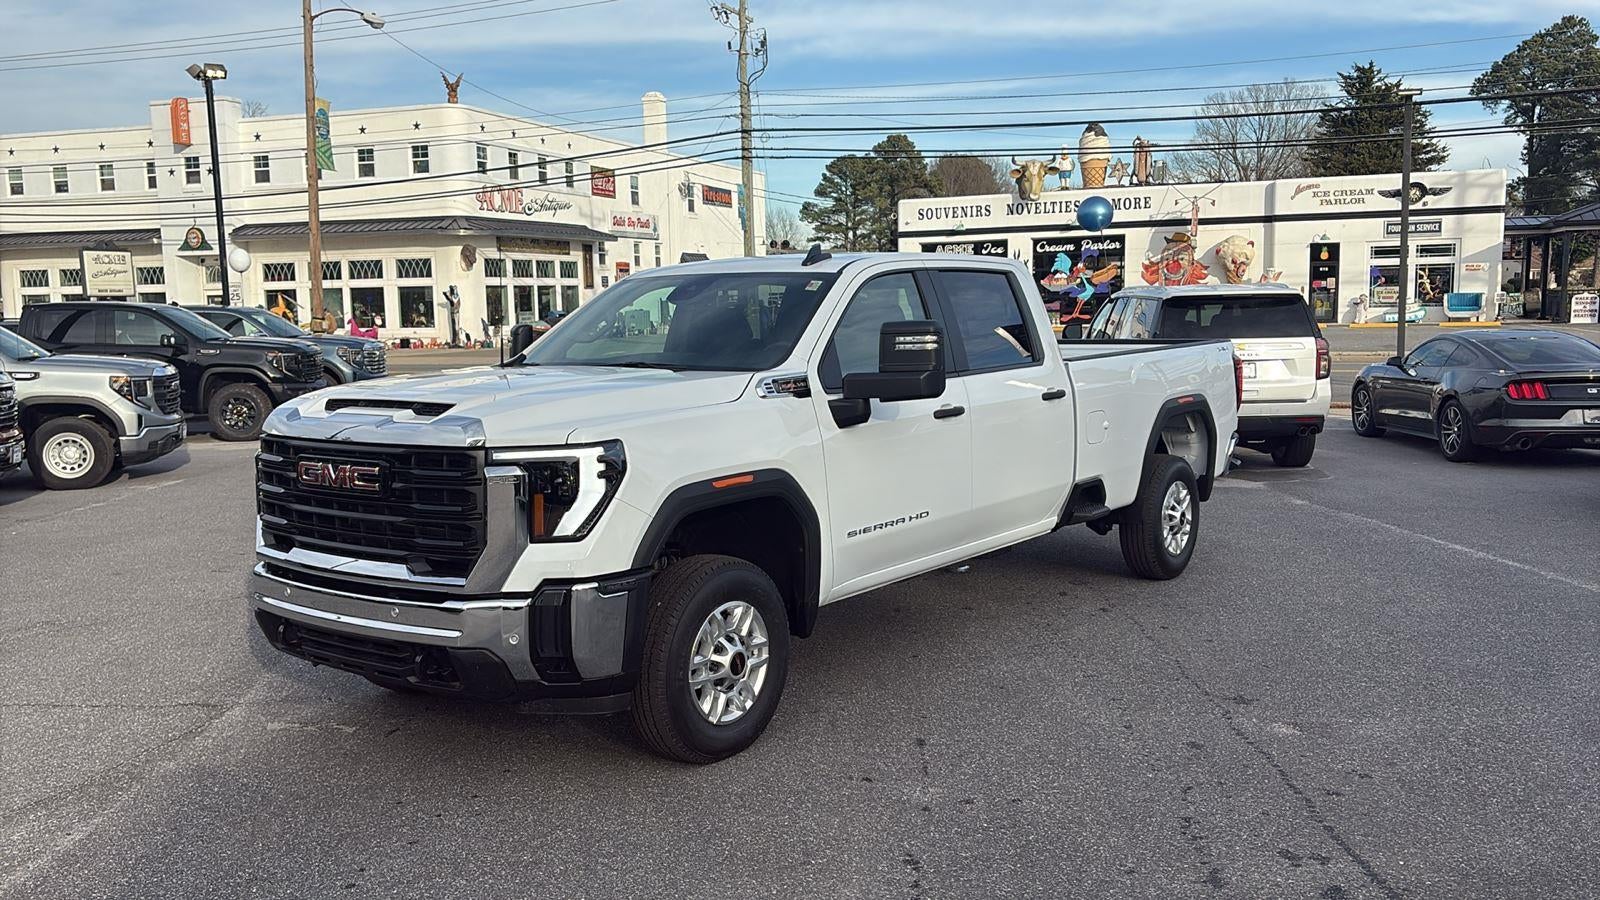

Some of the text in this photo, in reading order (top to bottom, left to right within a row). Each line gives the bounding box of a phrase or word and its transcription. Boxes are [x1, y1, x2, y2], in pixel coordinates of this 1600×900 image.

[179, 101, 188, 141] ACME
[703, 184, 732, 204] Firestone
[1291, 183, 1321, 200] Acme
[1312, 188, 1375, 198] ICE CREAM
[475, 186, 524, 214] ACME
[1320, 198, 1366, 206] PARLOR
[917, 197, 1152, 221] SOUVENIRS NOVELTIES MORE
[627, 216, 636, 230] Boy
[1416, 223, 1440, 231] SERVICE
[935, 242, 1006, 255] ACME Ice
[1036, 239, 1123, 253] Cream Parlor
[230, 292, 241, 301] 25
[298, 461, 380, 491] GMC
[847, 511, 930, 538] SIERRA HD
